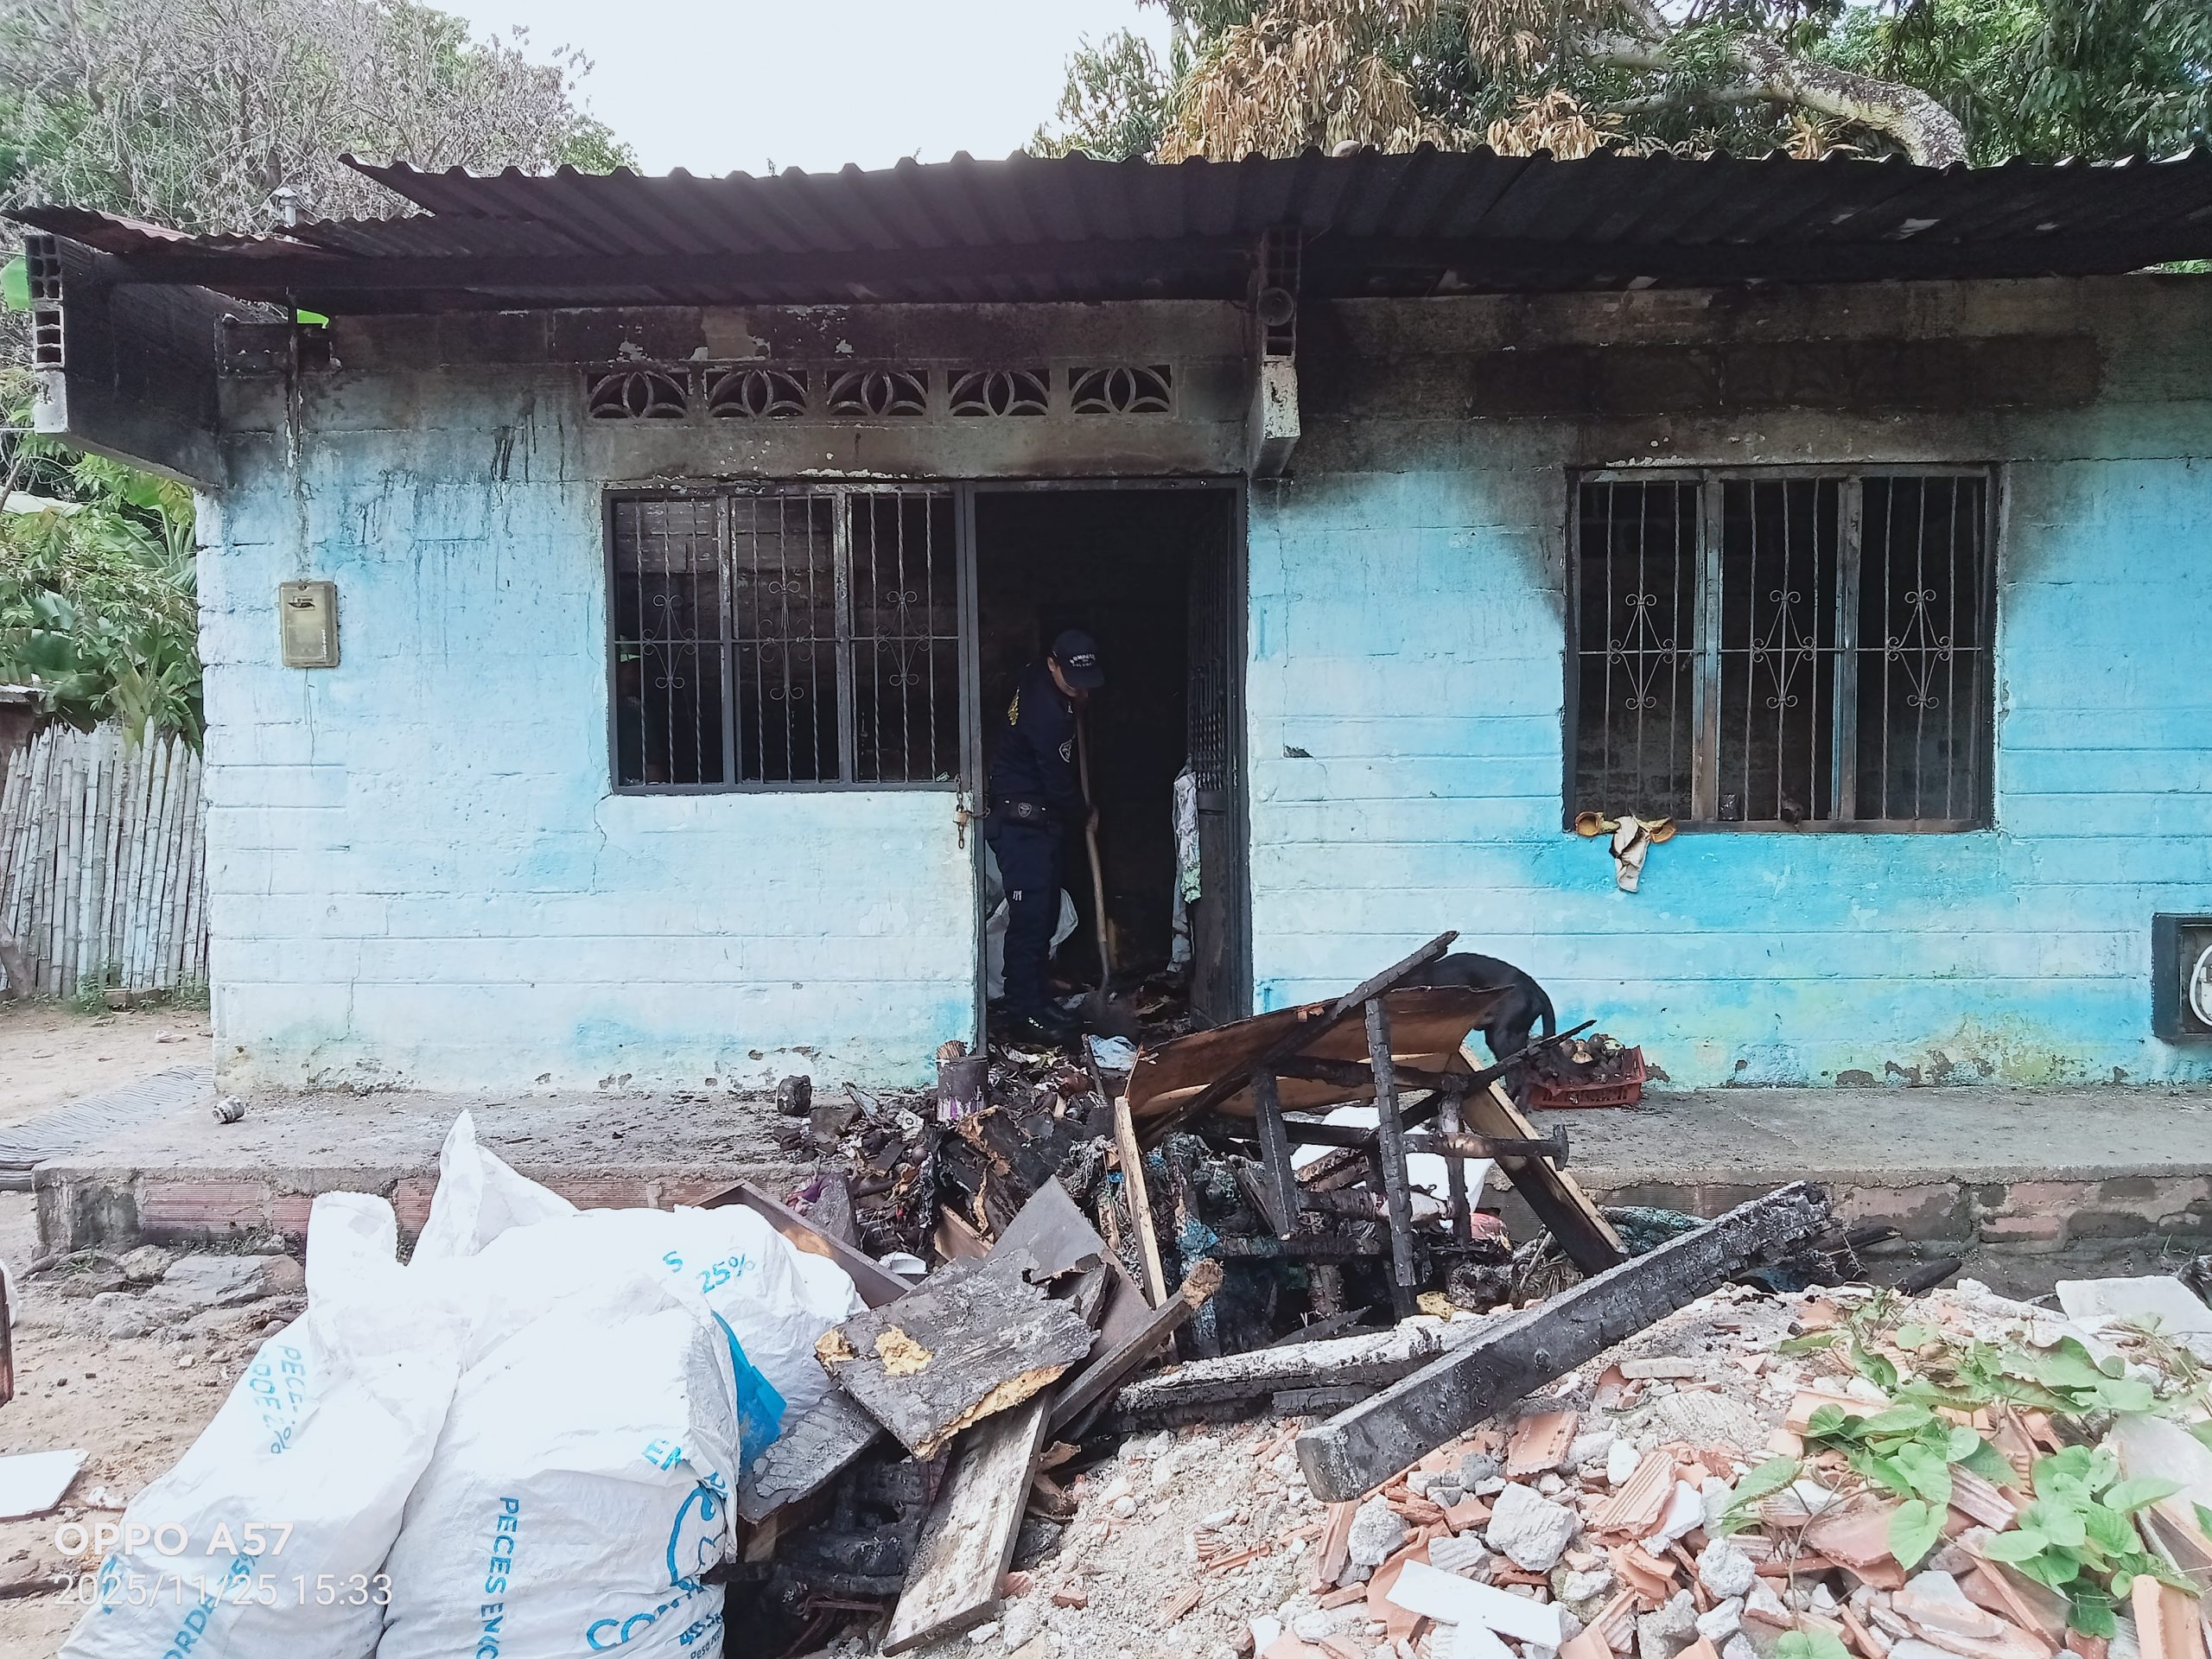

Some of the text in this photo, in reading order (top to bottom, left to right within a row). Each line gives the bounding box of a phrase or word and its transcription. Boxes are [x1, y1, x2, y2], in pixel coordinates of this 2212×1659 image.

[696, 1253, 755, 1294] 25%
[277, 1344, 306, 1413] PECE
[485, 1497, 519, 1594] PECES
